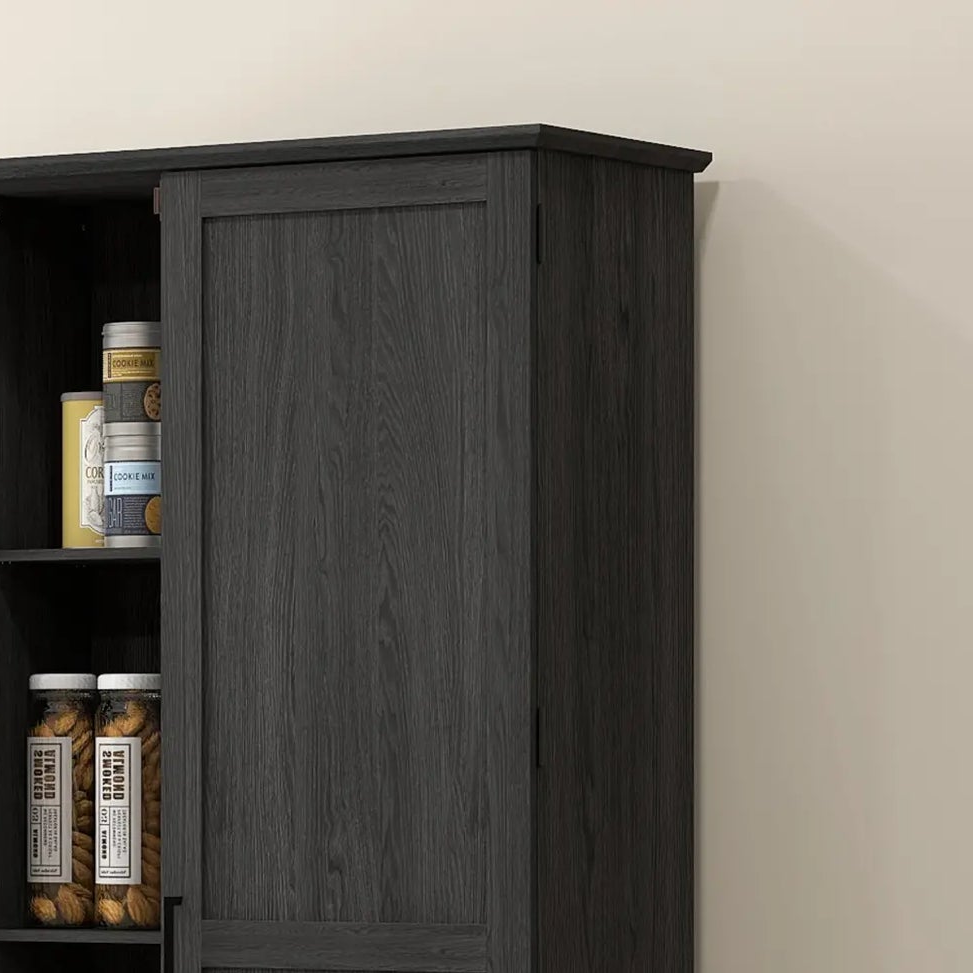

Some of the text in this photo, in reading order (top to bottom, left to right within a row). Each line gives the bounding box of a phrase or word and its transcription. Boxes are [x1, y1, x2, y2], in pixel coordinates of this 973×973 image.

[112, 359, 139, 368] COOKIE
[114, 472, 156, 481] COOKIE MIX
